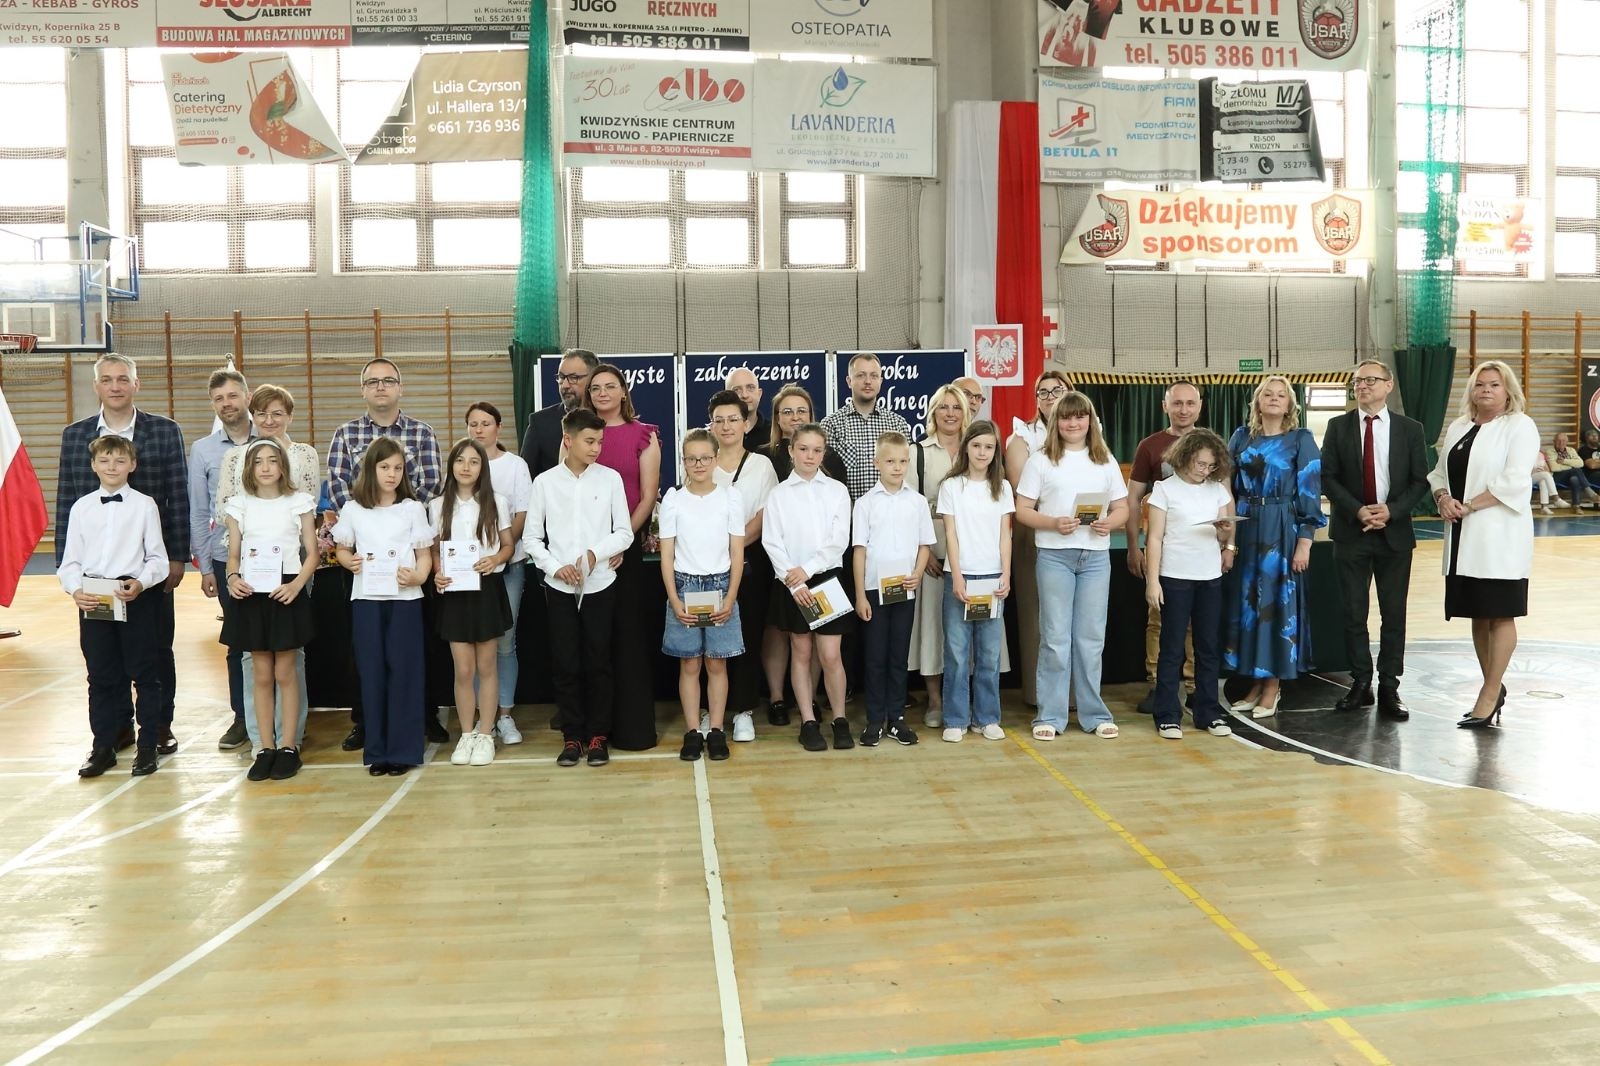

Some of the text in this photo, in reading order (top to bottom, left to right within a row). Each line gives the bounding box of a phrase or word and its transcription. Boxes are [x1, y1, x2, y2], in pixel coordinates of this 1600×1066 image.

[32, 0, 78, 8] KEBAB
[92, 0, 139, 8] GYROS
[569, 0, 617, 13] JUGO
[647, 1, 717, 18] RĘCZNYCH
[261, 8, 312, 17] ALBRECHT
[45, 23, 95, 32] Kopernika
[566, 20, 597, 29] KWIDZYN
[613, 23, 654, 31] KOPERNIKA
[680, 26, 705, 34] PIĘTRO
[712, 27, 742, 35] JAMNIK)
[791, 22, 891, 37] OSTEOPATIA
[1140, 17, 1280, 38] KLUBOWE
[1309, 21, 1349, 39] USAR
[9, 35, 109, 44] tel. 55 620 05 54
[162, 28, 346, 42] BUDOWA HAL MAGAZYNOWYCH
[590, 34, 720, 50] tel. 505 386 011
[1125, 43, 1299, 68] tel. 505 386 011
[433, 80, 522, 95] Lidia Czyrson
[583, 77, 614, 101] 30
[659, 68, 745, 103] elbo
[173, 92, 226, 105] Catering
[1230, 87, 1266, 99] ZŁOMU
[427, 102, 443, 115] ul.
[447, 100, 494, 113] Hallera
[1164, 97, 1196, 107] FIRM
[1224, 99, 1267, 109] demontażu
[175, 104, 242, 115] Dietetyczny
[437, 119, 521, 134] 661 736 936
[580, 115, 735, 129] KWIDZYŃSKIE CENTRUM
[791, 113, 896, 134] LAVANDERIA
[580, 129, 735, 143] BIUROWO PAPIERNICZE
[1126, 132, 1196, 140] MEDYCZNYCH
[595, 144, 606, 152] ul.
[616, 145, 637, 153] Maja
[683, 146, 720, 156] Kwidzyn
[1043, 146, 1119, 158] BETULA IT
[1250, 142, 1281, 150] KWIDZYN
[610, 158, 706, 168] www.elbokwidzyn.pl
[807, 158, 880, 168] www.lavanderia.pl
[1139, 197, 1298, 230] Dziękujemy
[1085, 226, 1123, 242] USAR
[1142, 235, 1298, 259] sponsorom
